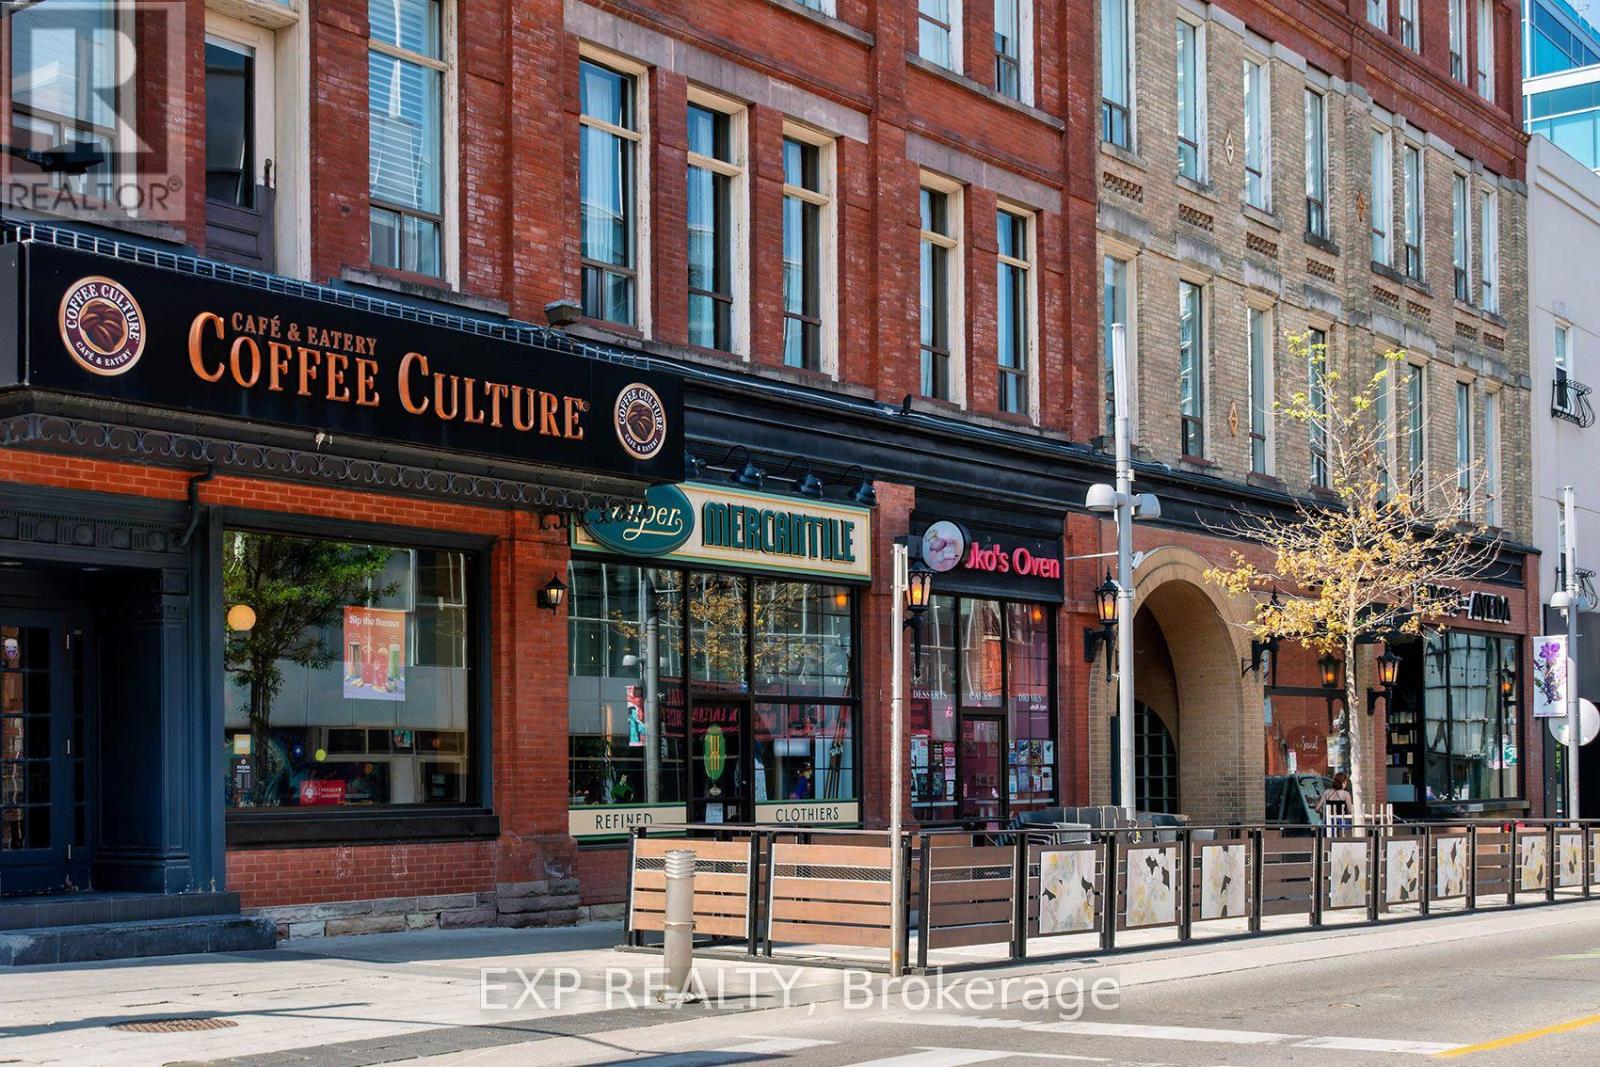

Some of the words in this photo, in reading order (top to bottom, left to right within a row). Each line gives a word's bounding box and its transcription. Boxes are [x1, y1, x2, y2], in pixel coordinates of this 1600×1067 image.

[66, 284, 99, 329] COFFEE
[100, 284, 141, 341] CULTURE
[231, 311, 281, 338] CAFÉ
[287, 322, 301, 341] &
[307, 325, 377, 356] EATERY
[95, 357, 103, 366] &
[104, 348, 132, 367] EATERY
[188, 311, 380, 407] COFFEE
[618, 389, 638, 425] COFFEE
[702, 500, 856, 563] MERCANTILE
[1012, 547, 1060, 579] Oven
[775, 806, 840, 822] CLOTHIERS
